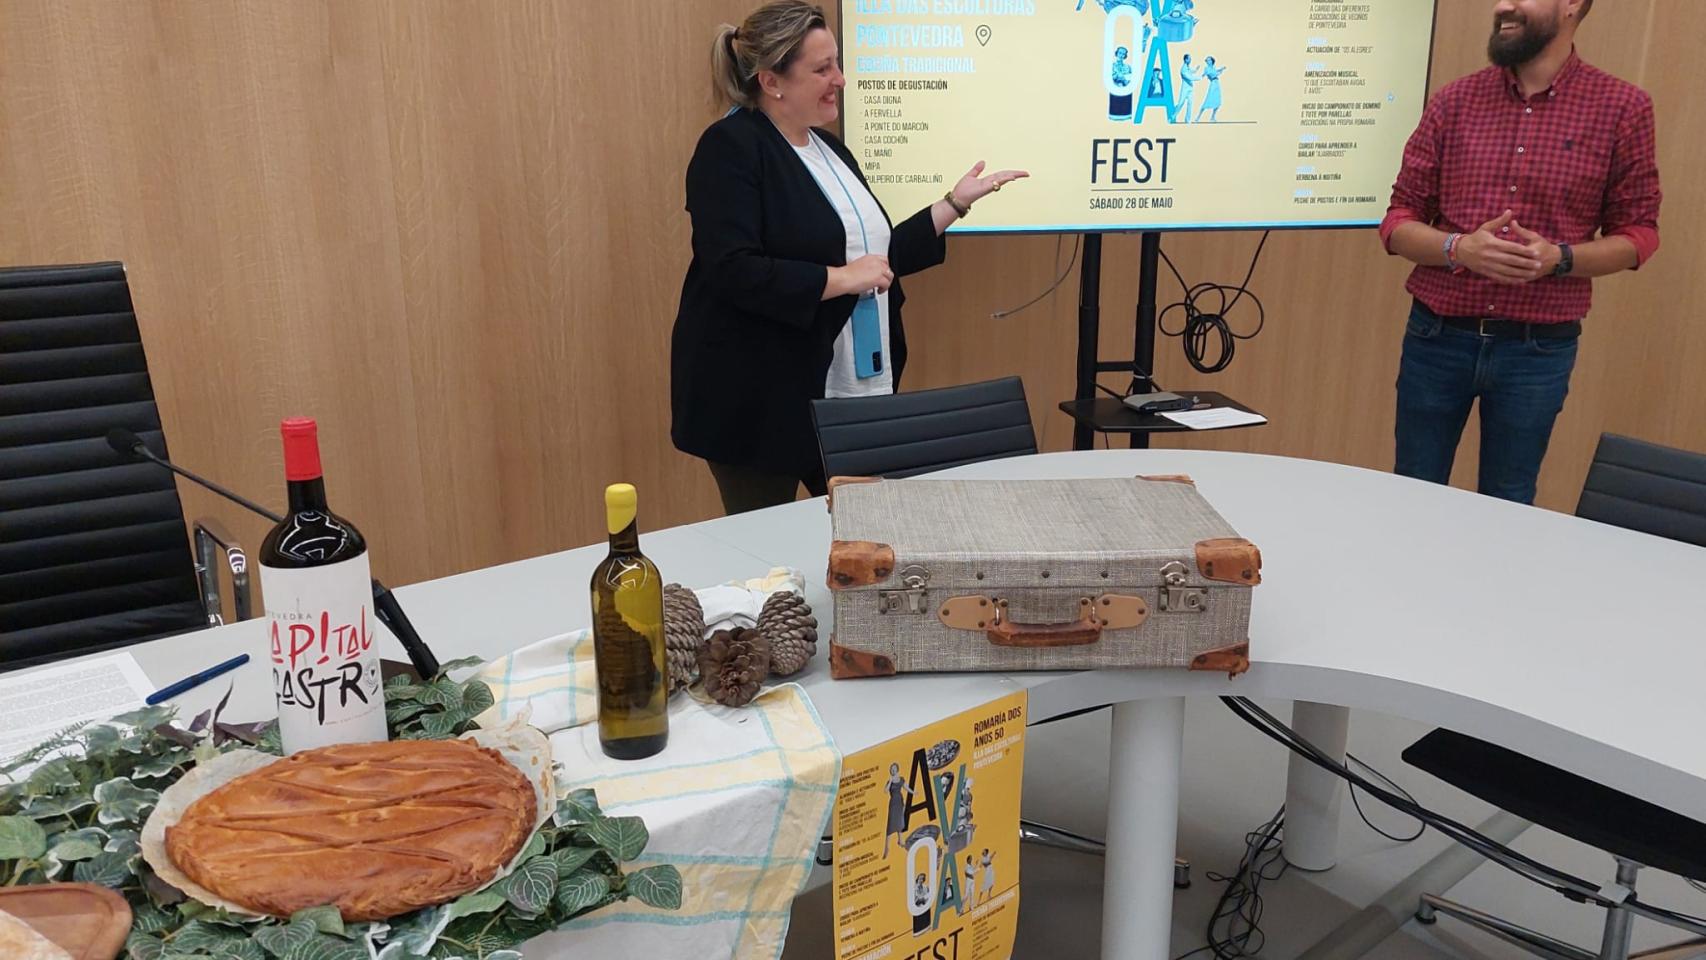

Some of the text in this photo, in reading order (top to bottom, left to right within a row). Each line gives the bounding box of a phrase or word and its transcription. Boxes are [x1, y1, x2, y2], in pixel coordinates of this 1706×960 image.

[856, 24, 964, 48] PONTEVEDRA
[903, 56, 976, 73] TRADICIONAL
[858, 78, 948, 90] POSTOS DE DEGUSTACIÓN
[864, 96, 902, 104] CASA DIGNA
[864, 109, 902, 118] A FERVELLA
[864, 121, 929, 130] A PONTE DO MARCÓN
[865, 134, 908, 144] CASA COCHÓN
[865, 149, 872, 157] EL
[865, 162, 880, 170] MIPA
[1091, 138, 1176, 184] FEST
[864, 173, 943, 183] PULPEIRO DE CARBALLIÑO
[1090, 196, 1173, 209] SÁBADO 28 DE MAIO
[974, 706, 1022, 735] ROMARÍA DOS
[974, 726, 1004, 748] ANOS 50
